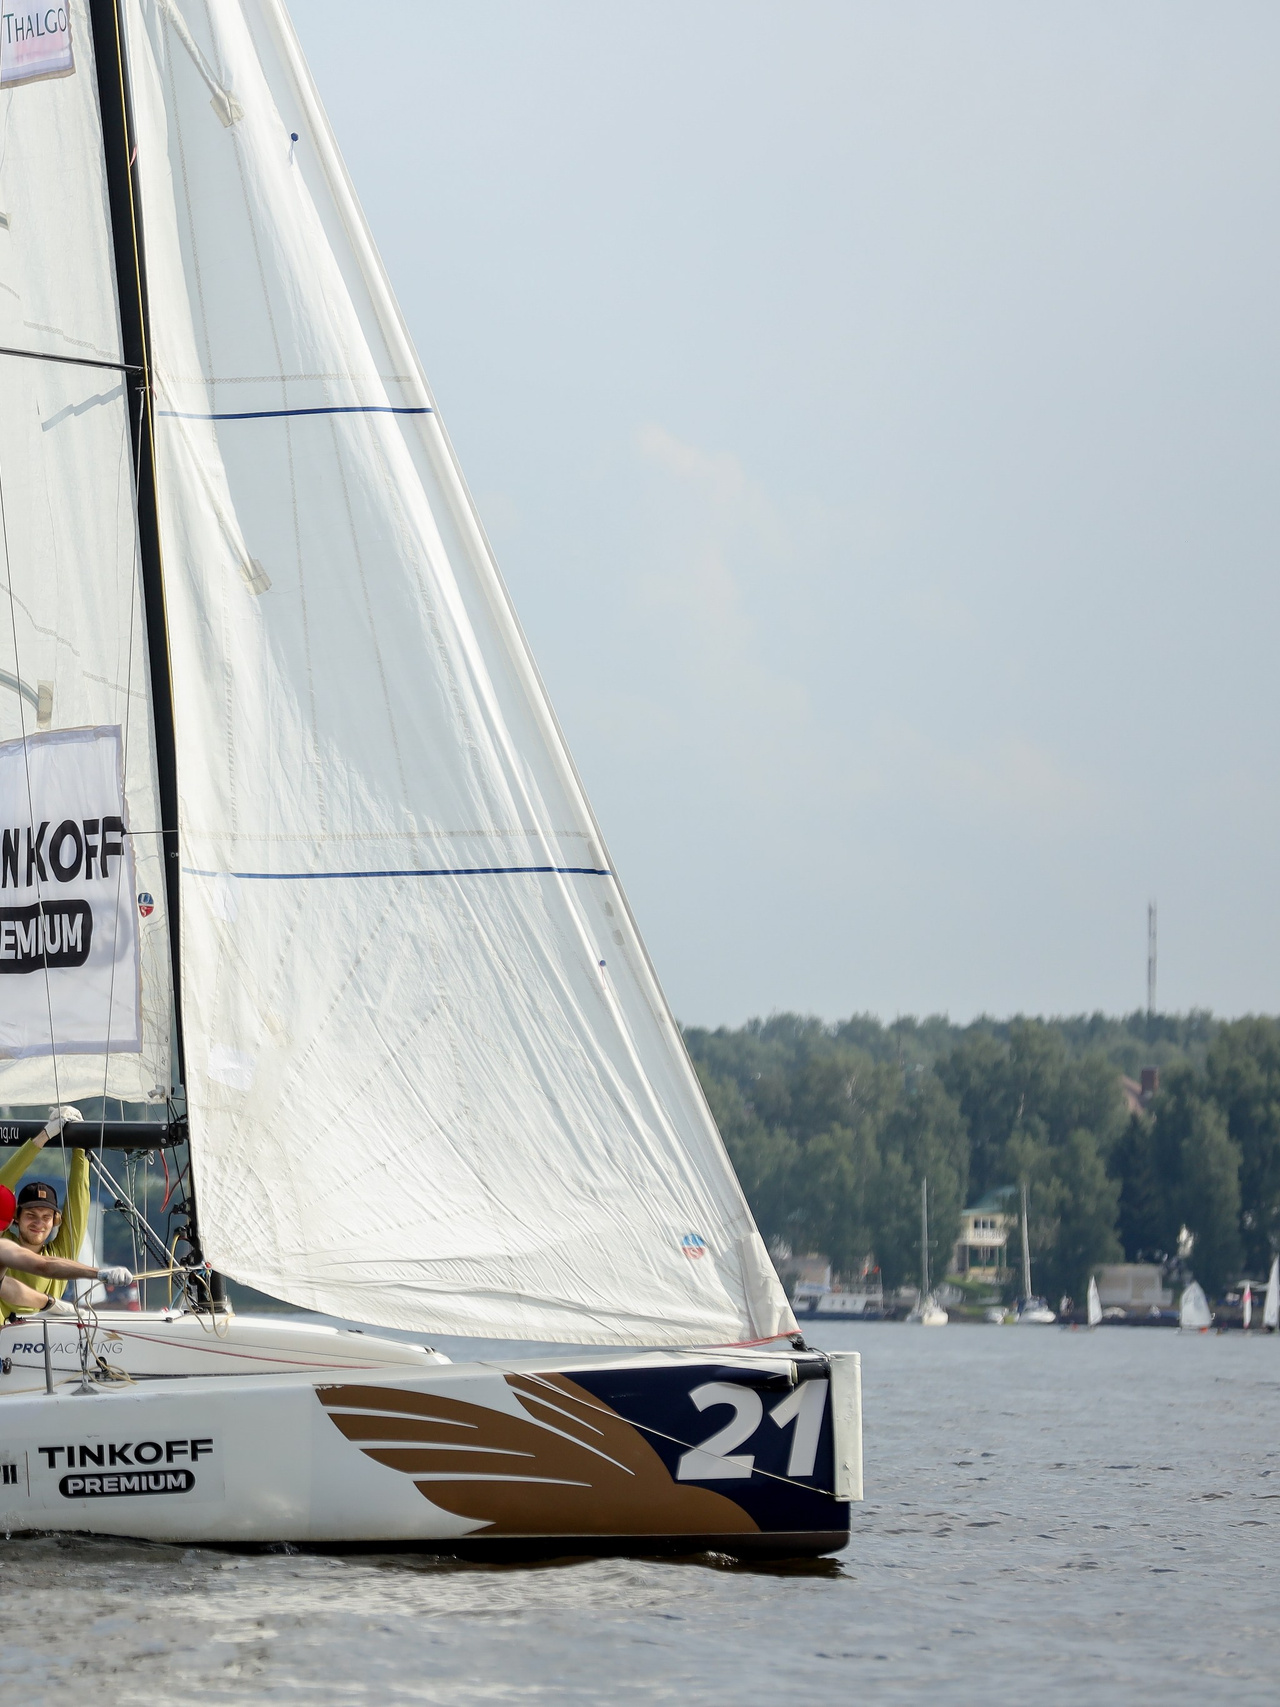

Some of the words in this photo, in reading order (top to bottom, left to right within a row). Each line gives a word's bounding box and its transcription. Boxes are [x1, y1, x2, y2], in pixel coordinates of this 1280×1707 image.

[677, 1378, 829, 1481] 21
[38, 1438, 214, 1469] TINKOFF
[68, 1473, 186, 1495] PREMIUM
